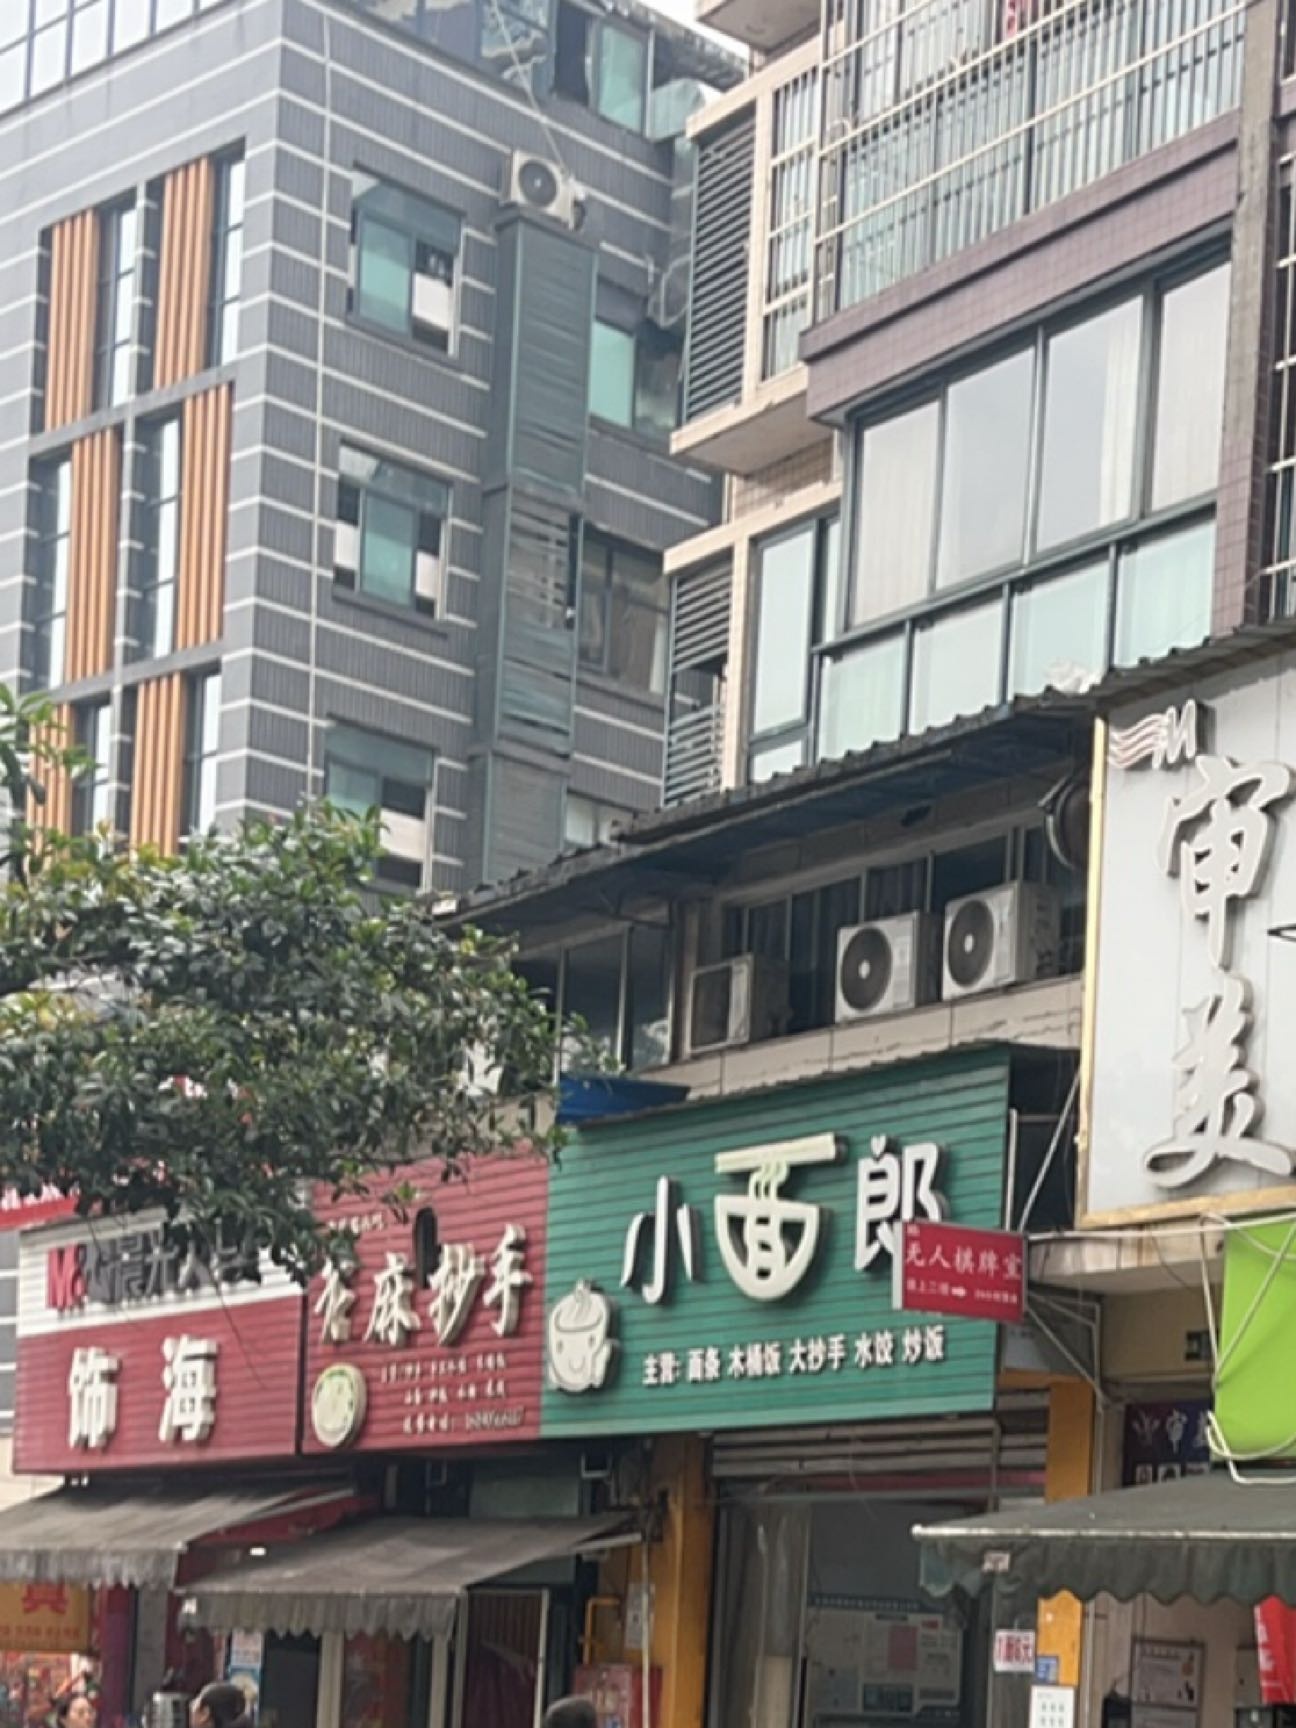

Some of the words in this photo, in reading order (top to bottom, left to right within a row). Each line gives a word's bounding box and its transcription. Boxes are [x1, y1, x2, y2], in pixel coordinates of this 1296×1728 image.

[906, 1240, 1022, 1279] 无人棋牌室
[854, 1329, 894, 1369] 水饺
